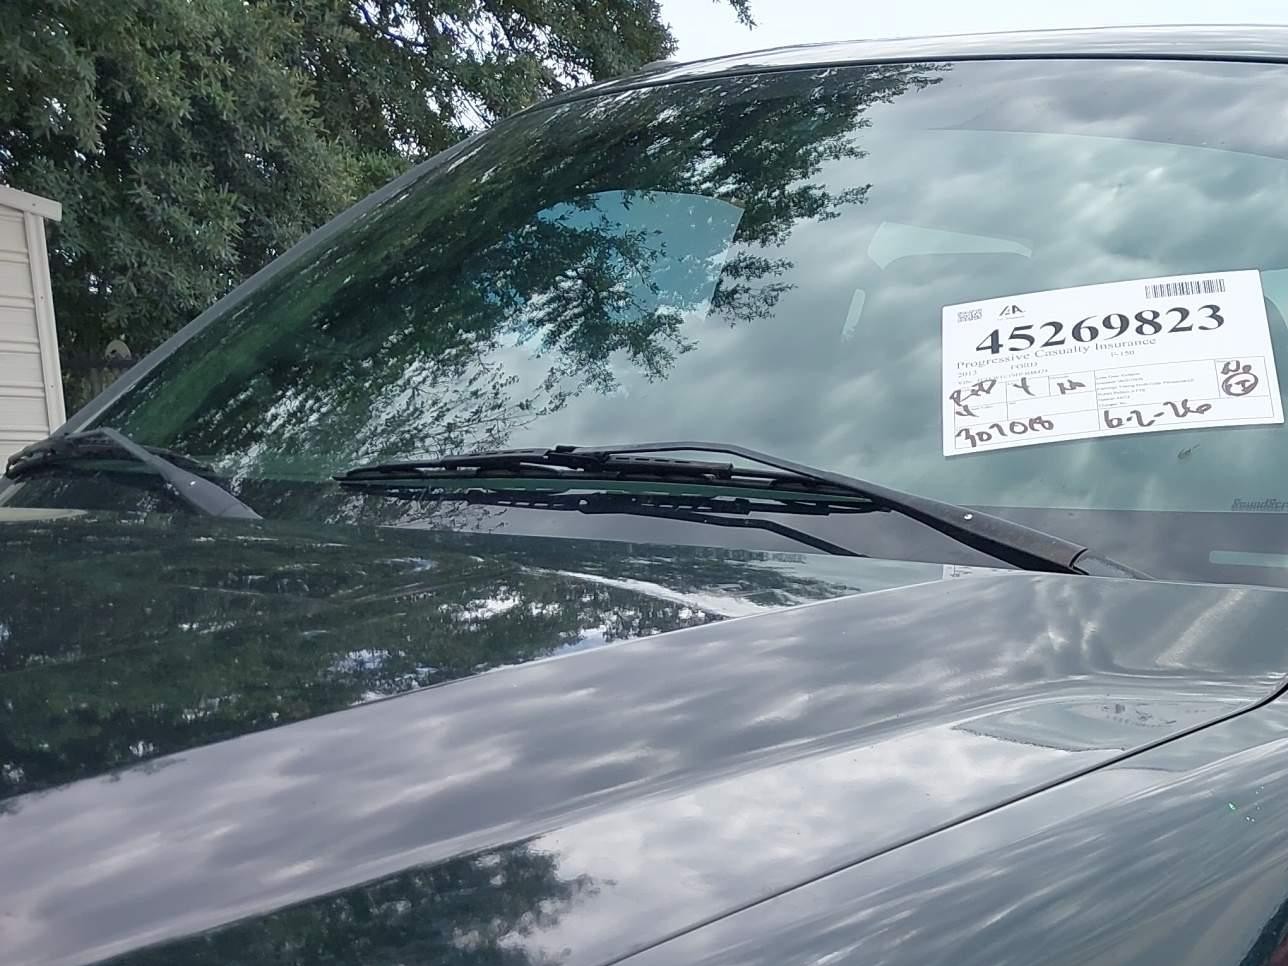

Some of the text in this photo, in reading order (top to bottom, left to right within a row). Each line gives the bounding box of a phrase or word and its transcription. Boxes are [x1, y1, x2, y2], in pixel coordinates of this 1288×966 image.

[975, 303, 1226, 355] 45269823
[956, 337, 1157, 370] Progressive Casualty Insurance
